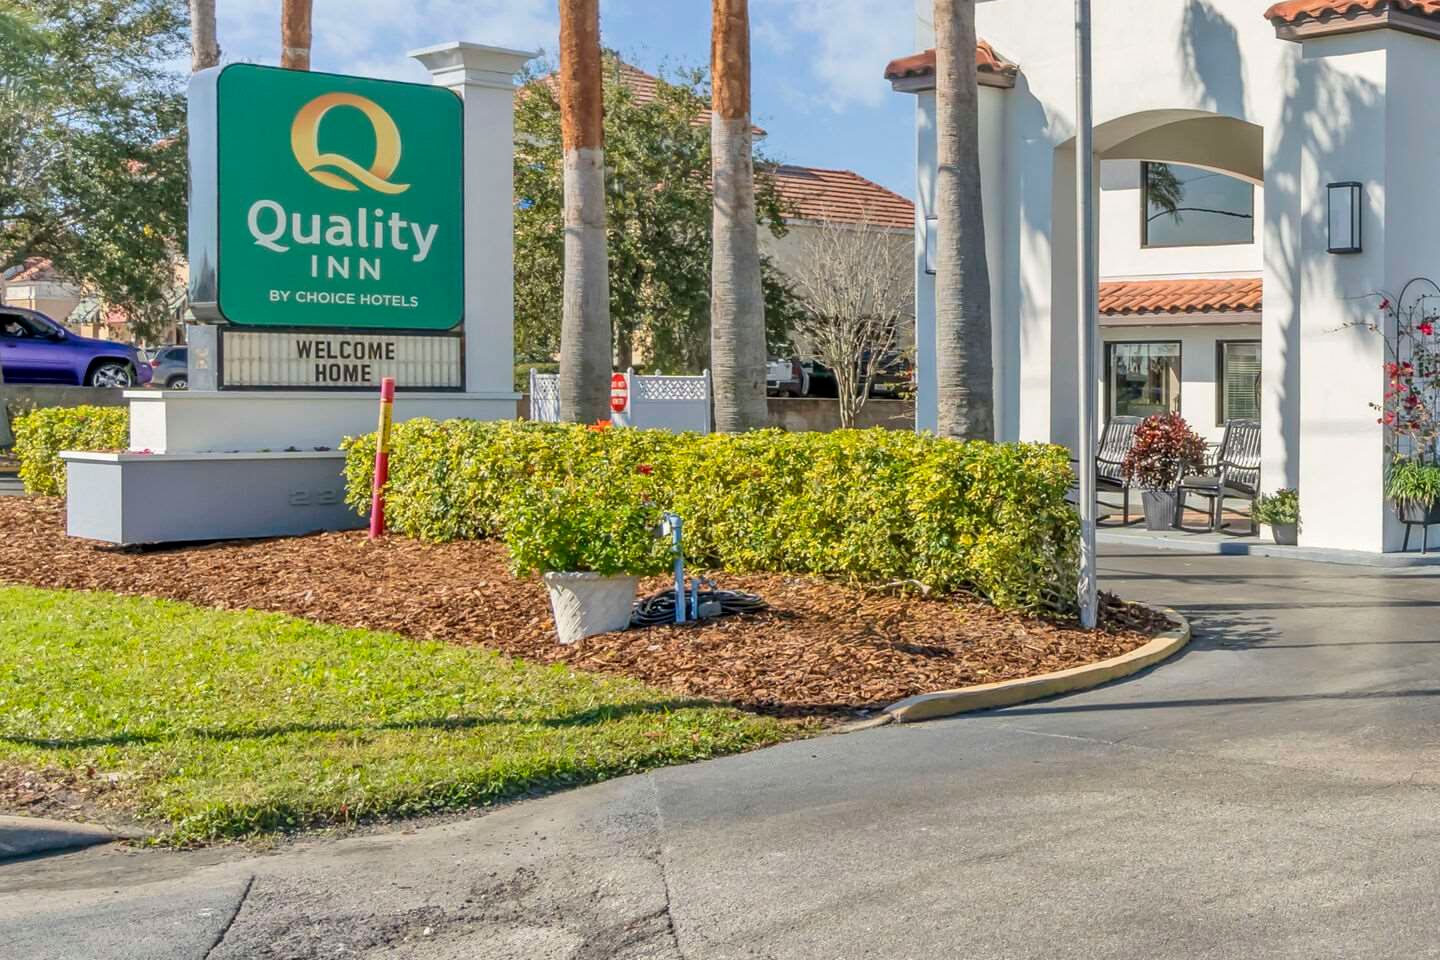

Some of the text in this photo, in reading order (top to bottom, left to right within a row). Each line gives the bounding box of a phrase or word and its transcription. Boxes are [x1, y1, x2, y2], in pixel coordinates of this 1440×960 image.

[291, 92, 411, 194] Q
[247, 199, 439, 262] Quality
[311, 255, 381, 280] INN
[269, 290, 419, 307] BY CHOICE HOTELS
[296, 340, 395, 360] WELCOME
[315, 364, 371, 382] HOME
